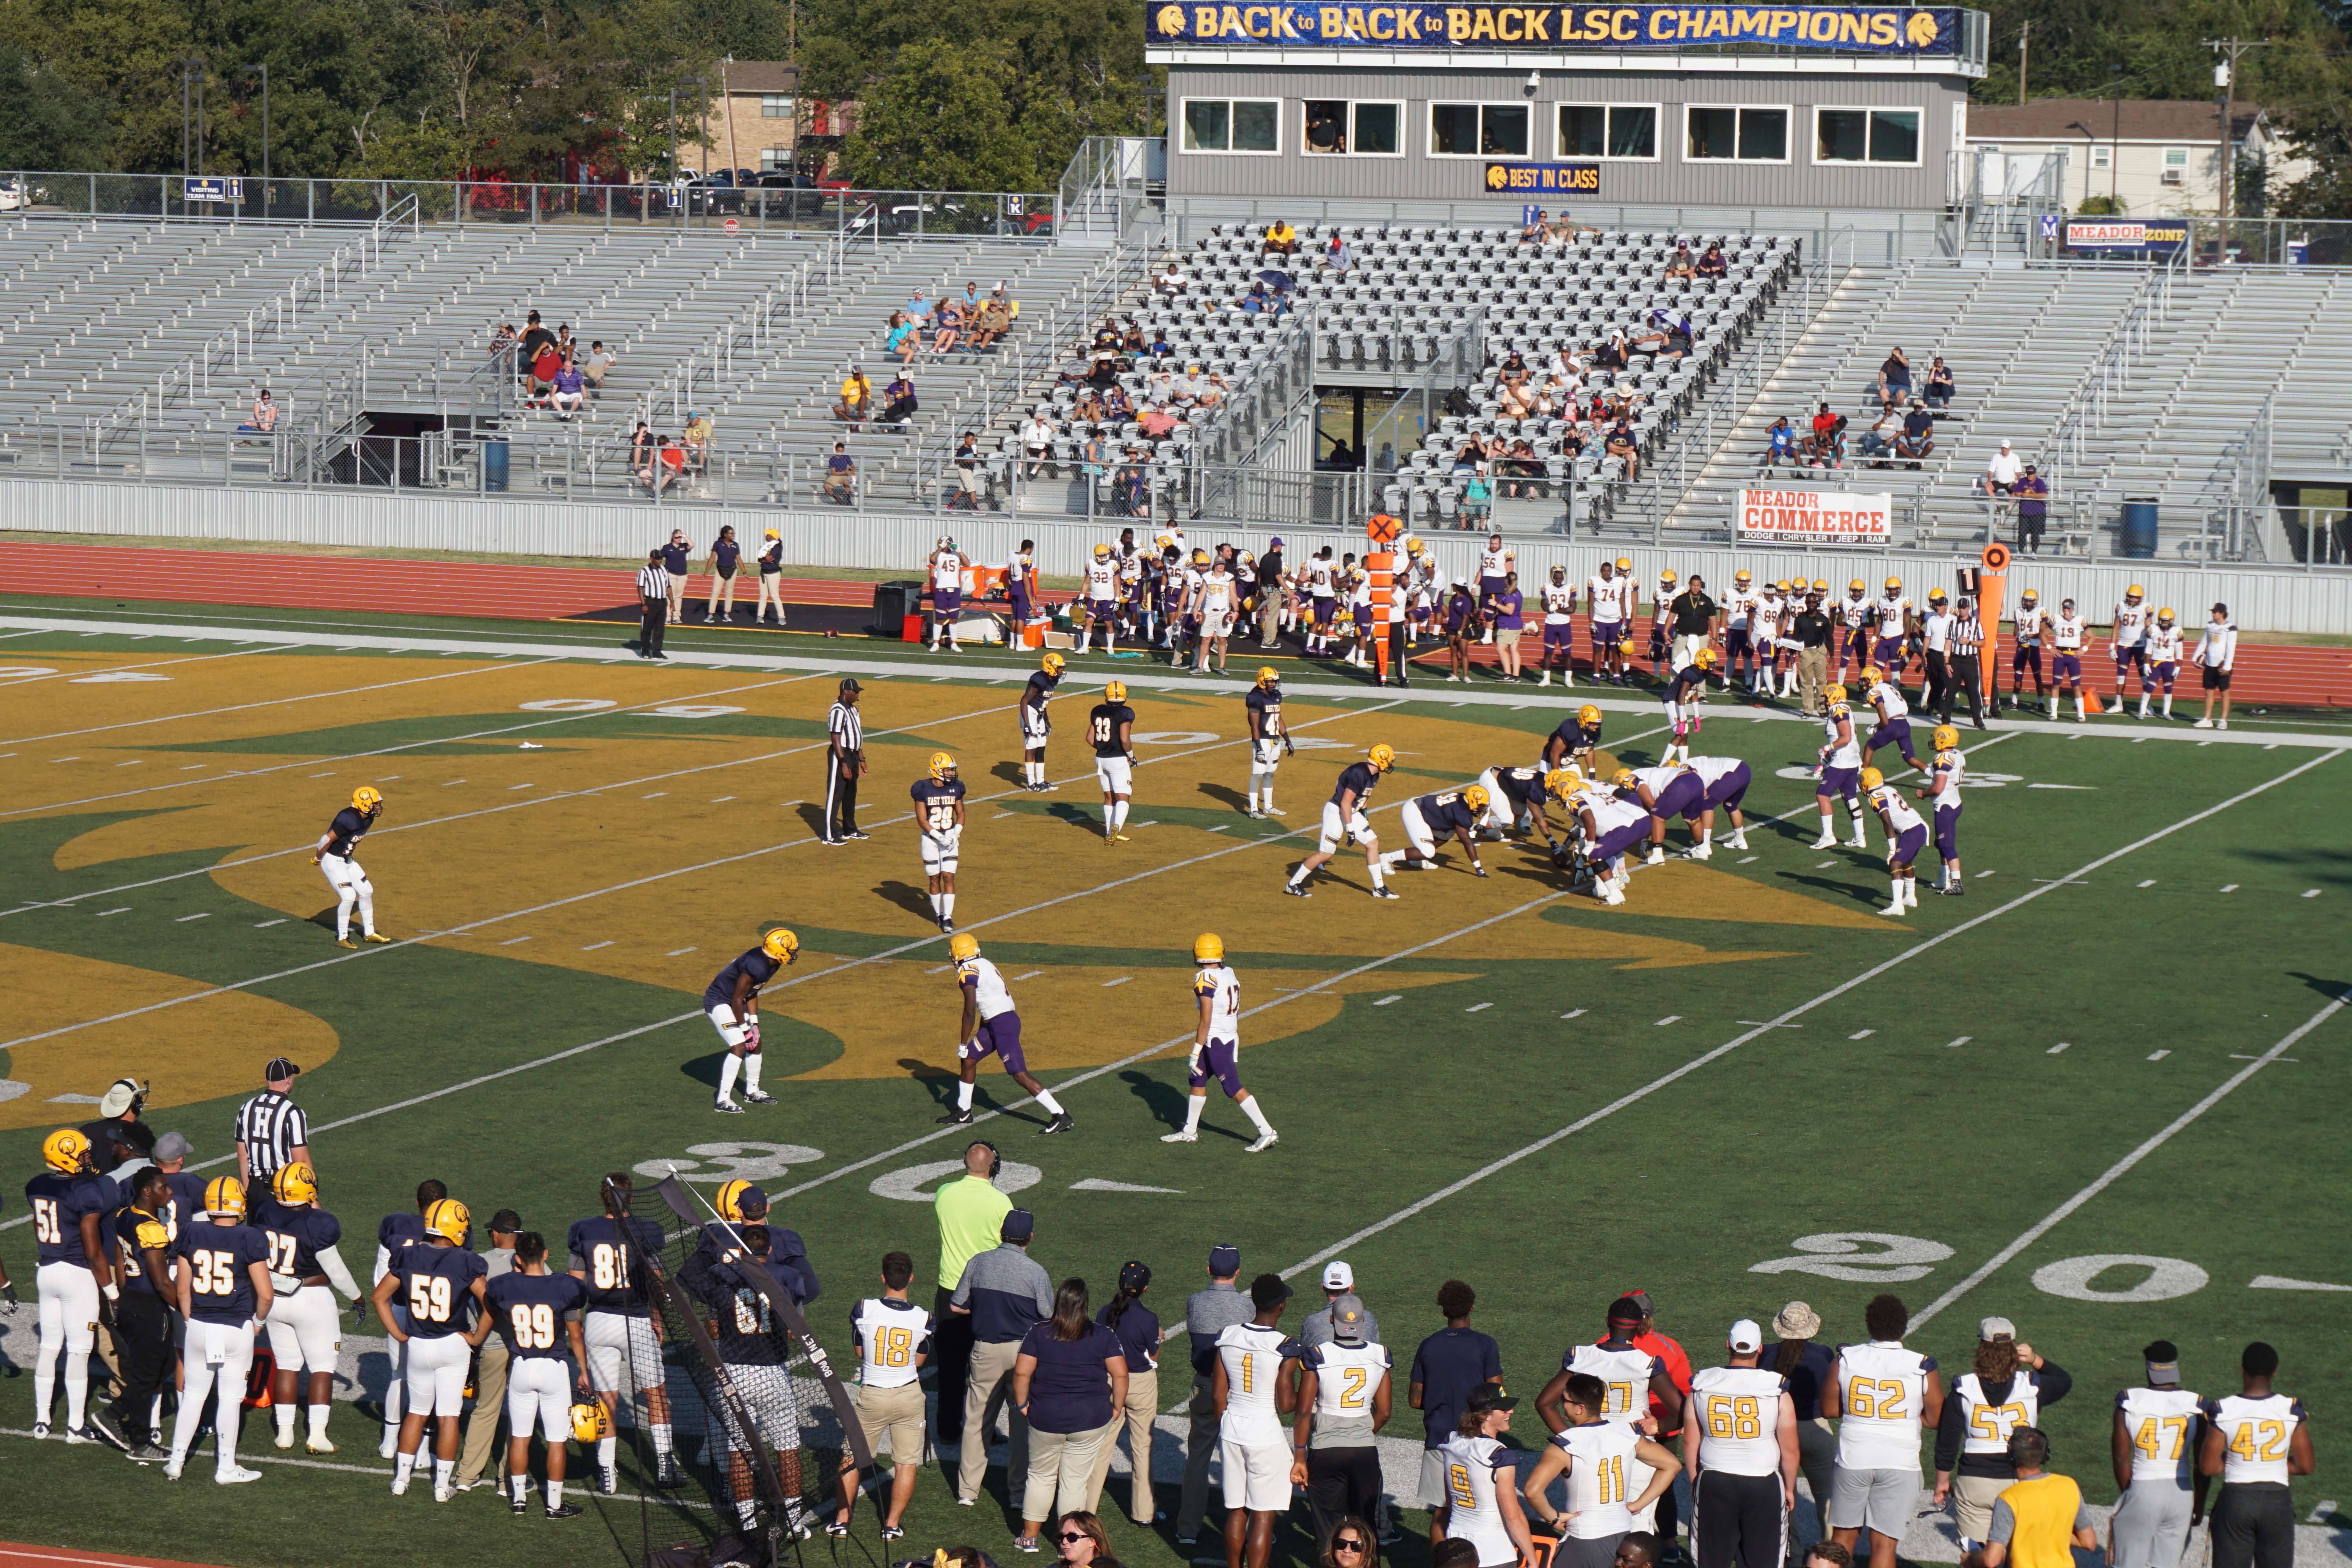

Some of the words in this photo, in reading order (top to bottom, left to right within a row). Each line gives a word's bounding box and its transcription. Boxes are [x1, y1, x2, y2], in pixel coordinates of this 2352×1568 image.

[1196, 6, 1299, 37] BACK
[1298, 13, 1314, 30] to
[1320, 8, 1423, 40] BACK
[1425, 16, 1443, 31] to
[1447, 9, 1551, 40] BACK
[1561, 9, 1639, 40] LSC
[1649, 10, 1897, 45] CHAMPIONS
[1510, 169, 1539, 187] BEST
[1542, 170, 1555, 187] IN
[1559, 169, 1597, 188] CLASS
[1010, 203, 1020, 213] K
[2042, 223, 2058, 236] M
[2070, 227, 2143, 238] MEADOR
[2145, 229, 2186, 241] ZONE
[1746, 490, 1818, 508] MEADOR
[1746, 508, 1884, 533] COMMERCE
[1782, 534, 1828, 542] CHRYSLER
[942, 560, 955, 572] 45
[1122, 558, 1134, 570] 22
[1168, 567, 1181, 578] 36
[1484, 557, 1496, 569] 56
[1093, 571, 1108, 583] 32
[1209, 584, 1223, 595] 94
[1963, 568, 1974, 590] 1
[1601, 589, 1615, 601] 74
[1735, 600, 1750, 613] 78
[2061, 627, 2074, 637] 19
[2123, 613, 2138, 627] 87
[1095, 717, 1110, 742] 33
[927, 796, 940, 806] EAST
[941, 796, 956, 806] TEXAS
[1227, 985, 1240, 1015] 17
[252, 1106, 272, 1138] H
[34, 1199, 62, 1244] 51
[265, 1230, 296, 1274] 97
[192, 1249, 234, 1294] 35
[593, 1243, 631, 1289] 81
[411, 1274, 451, 1322] 59
[733, 1287, 771, 1334] 61
[511, 1304, 555, 1349] 89
[874, 1326, 913, 1367] 18
[1241, 1353, 1253, 1393] 1
[1340, 1367, 1367, 1408] 2
[1848, 1375, 1907, 1419] 62
[1708, 1395, 1760, 1439] 68
[1971, 1401, 2029, 1441] 53
[2135, 1416, 2189, 1460] 47
[2231, 1420, 2287, 1461] 42
[1451, 1464, 1475, 1508] 9
[1598, 1455, 1624, 1504] 11
